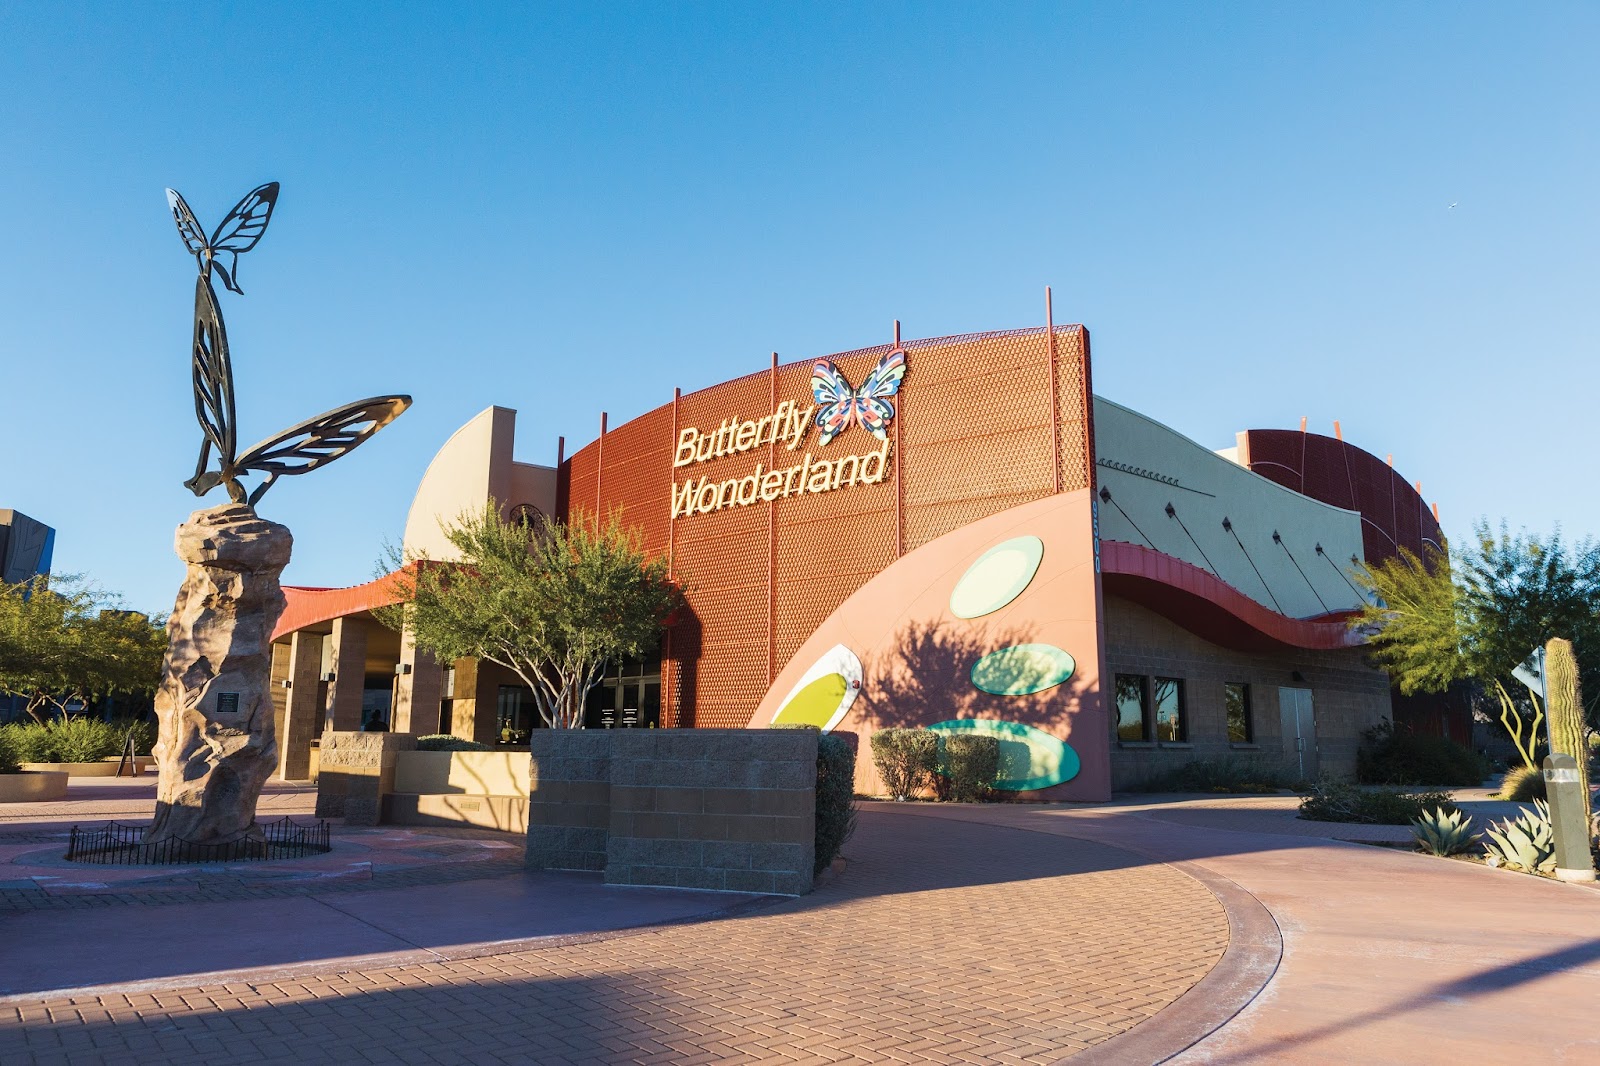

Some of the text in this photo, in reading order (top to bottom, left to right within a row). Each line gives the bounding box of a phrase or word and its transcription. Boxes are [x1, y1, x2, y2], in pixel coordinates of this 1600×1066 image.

[674, 399, 814, 468] Butterfly
[671, 438, 890, 519] Wonderland
[1092, 500, 1101, 574] 9500
